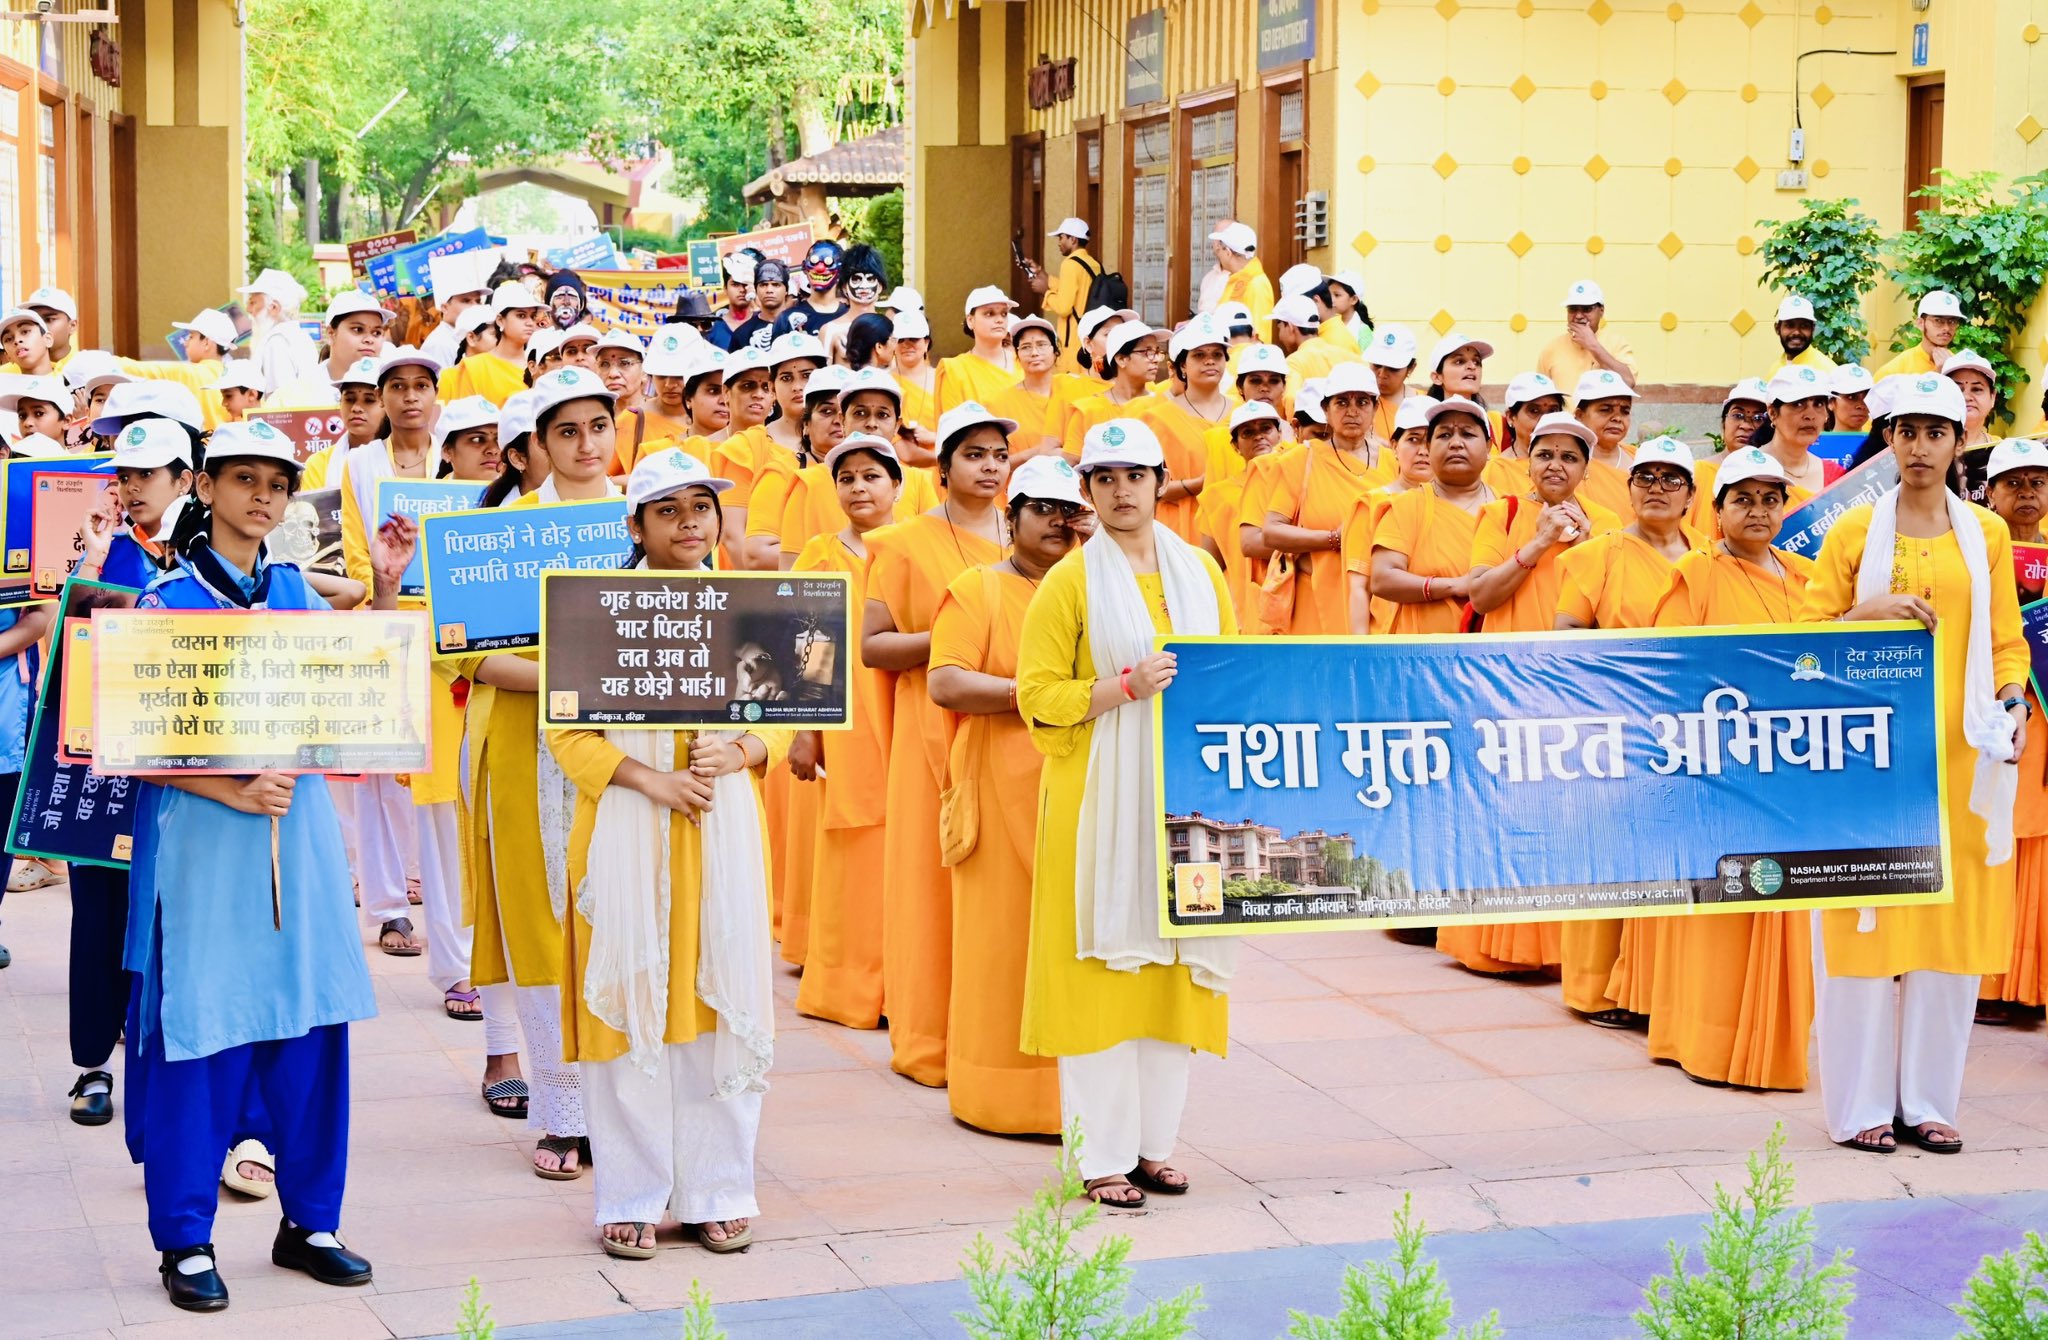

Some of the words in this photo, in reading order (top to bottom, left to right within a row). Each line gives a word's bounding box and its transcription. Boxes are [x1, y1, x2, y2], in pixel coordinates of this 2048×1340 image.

[443, 525, 515, 554] पियक्कड़ों
[520, 523, 536, 548] ने
[540, 521, 572, 549] होड़
[576, 514, 629, 542] लगाई
[449, 557, 509, 586] सम्पत्ति
[513, 560, 540, 580] घर
[600, 591, 632, 616] गृह
[635, 585, 689, 610] कलेश
[694, 585, 729, 611] और
[615, 620, 649, 639] मार
[170, 635, 218, 650] व्यसन
[223, 635, 267, 655] मनुष्य
[272, 630, 288, 651] के
[293, 635, 328, 651] पतन
[332, 636, 353, 651] का
[1844, 647, 1868, 663] देव
[1873, 644, 1924, 664] संस्कृति
[617, 649, 650, 668] लत
[654, 649, 685, 668] अब
[689, 642, 710, 668] तो
[133, 663, 161, 678] एक
[166, 658, 197, 678] ऐसा
[202, 658, 236, 679] मार्ग
[239, 658, 257, 681] है,
[261, 658, 296, 679] जिसे
[300, 664, 344, 683] मनुष्य
[350, 659, 390, 679] अपनी
[1844, 664, 1924, 681] विश्वविद्यालय
[600, 677, 630, 696] यह
[634, 671, 674, 700] छोड़ो
[138, 687, 187, 711] मूर्खता
[192, 687, 209, 707] के
[213, 692, 260, 707] कारण
[265, 692, 306, 707] ग्रहण
[311, 692, 352, 707] करता
[359, 687, 386, 707] और
[129, 715, 168, 736] अपने
[172, 715, 200, 736] पैरों
[203, 720, 225, 736] पर
[230, 720, 260, 736] आप
[265, 715, 320, 739] कुल्हाड़ी
[324, 720, 367, 736] मारता
[1195, 723, 1321, 790] नशा
[1334, 721, 1452, 809] मुक्त
[1473, 715, 1628, 783] भारत
[1648, 688, 1893, 776] अभियान
[49, 772, 71, 805] नशा
[40, 809, 63, 830] जो
[75, 796, 95, 820] वह
[106, 801, 124, 815] न
[1790, 865, 1821, 875] NASHA
[1823, 864, 1849, 874] MUKT
[1850, 863, 1886, 873] BHARAT
[1888, 861, 1934, 871] ABHIYAAN
[1790, 875, 1827, 885] Department
[1836, 874, 1856, 882] Social
[1857, 873, 1880, 881] Justice
[1889, 871, 1935, 881] Empowerment
[1242, 901, 1271, 917] विचार
[1273, 899, 1304, 915] क्रान्ति
[1307, 898, 1348, 914] अभियान
[1483, 892, 1576, 907] www.awgp.org
[1587, 886, 1685, 901] www.dsvv.ac.in
